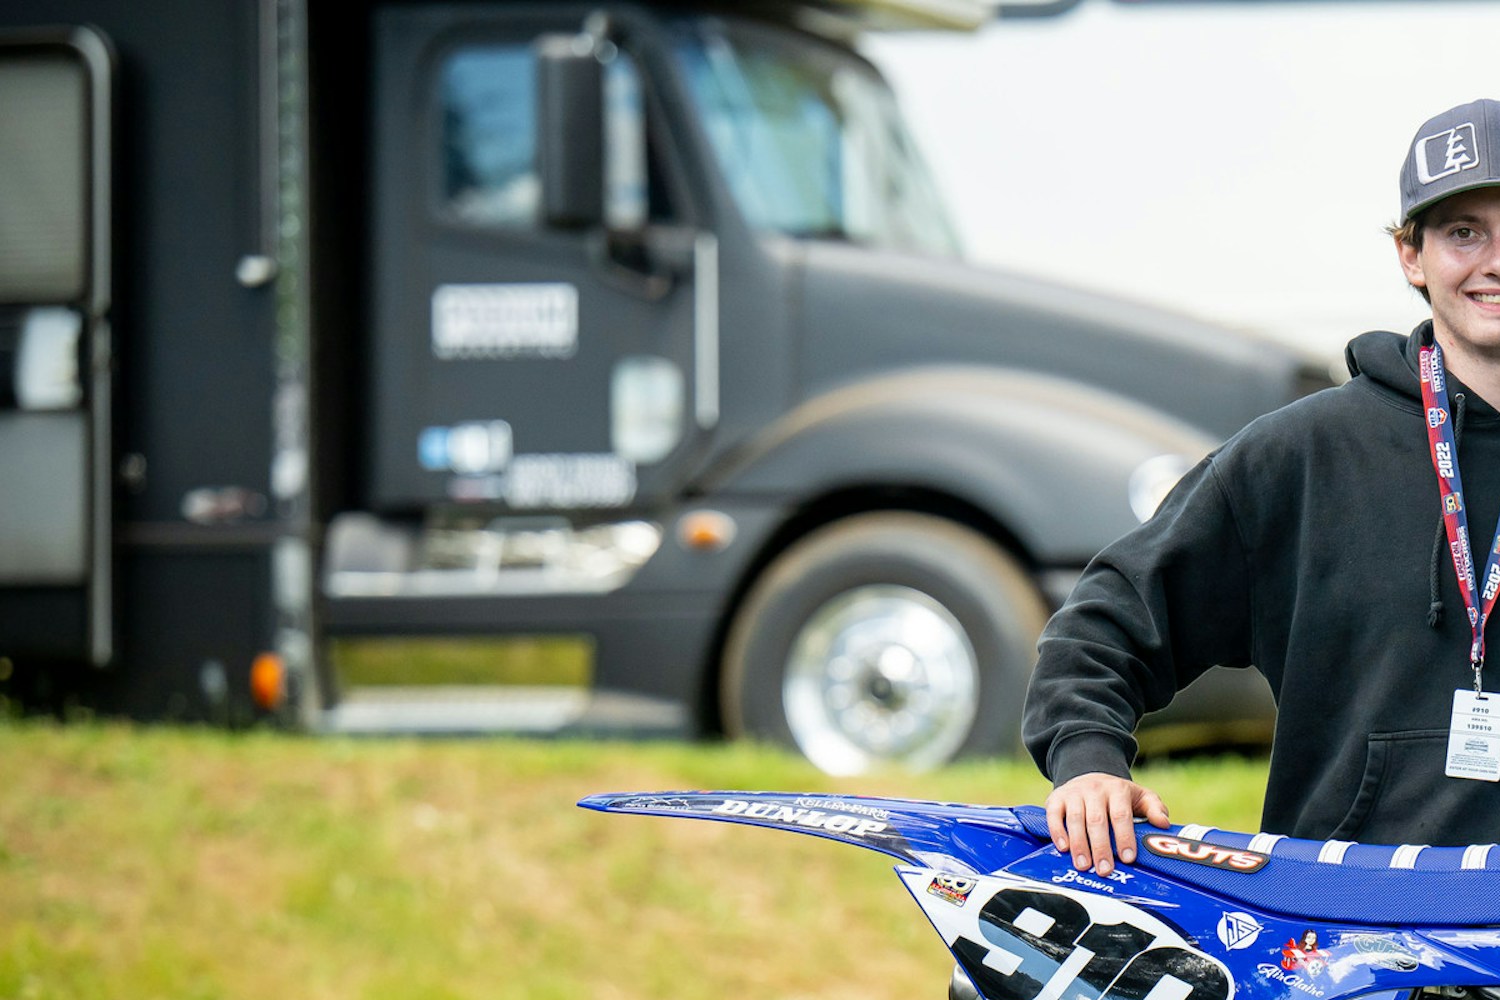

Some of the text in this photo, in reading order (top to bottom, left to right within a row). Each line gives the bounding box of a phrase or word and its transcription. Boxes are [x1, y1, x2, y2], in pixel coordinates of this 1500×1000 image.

[1436, 441, 1454, 478] 2022
[713, 799, 889, 835] DUNLOP
[1147, 836, 1264, 869] GUTS
